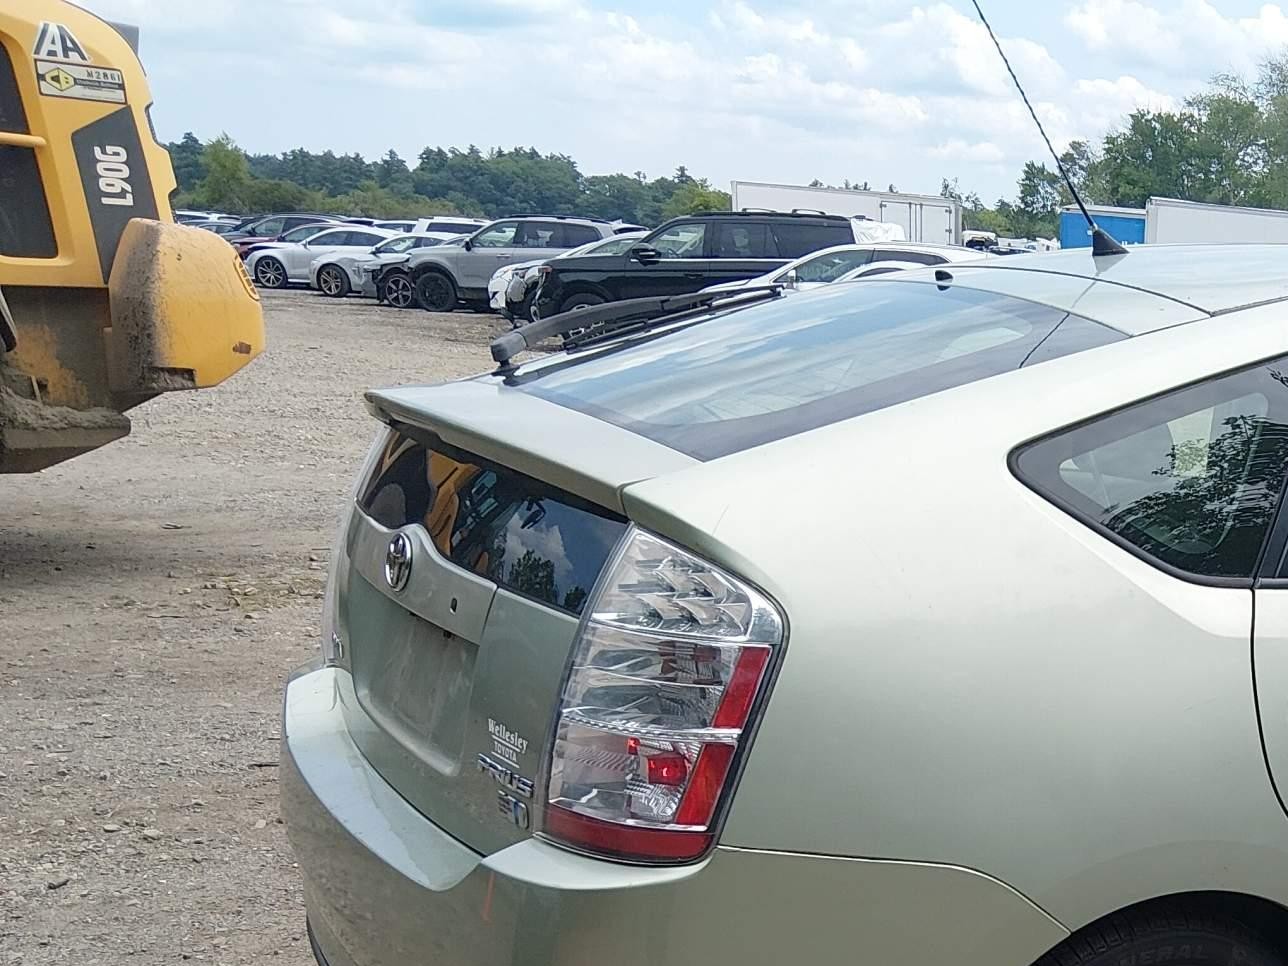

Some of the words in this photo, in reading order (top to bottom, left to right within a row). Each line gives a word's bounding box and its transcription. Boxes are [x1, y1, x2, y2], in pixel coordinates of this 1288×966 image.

[93, 145, 134, 206] L90G
[488, 718, 528, 754] Wellesley
[494, 740, 518, 763] TOYOTA
